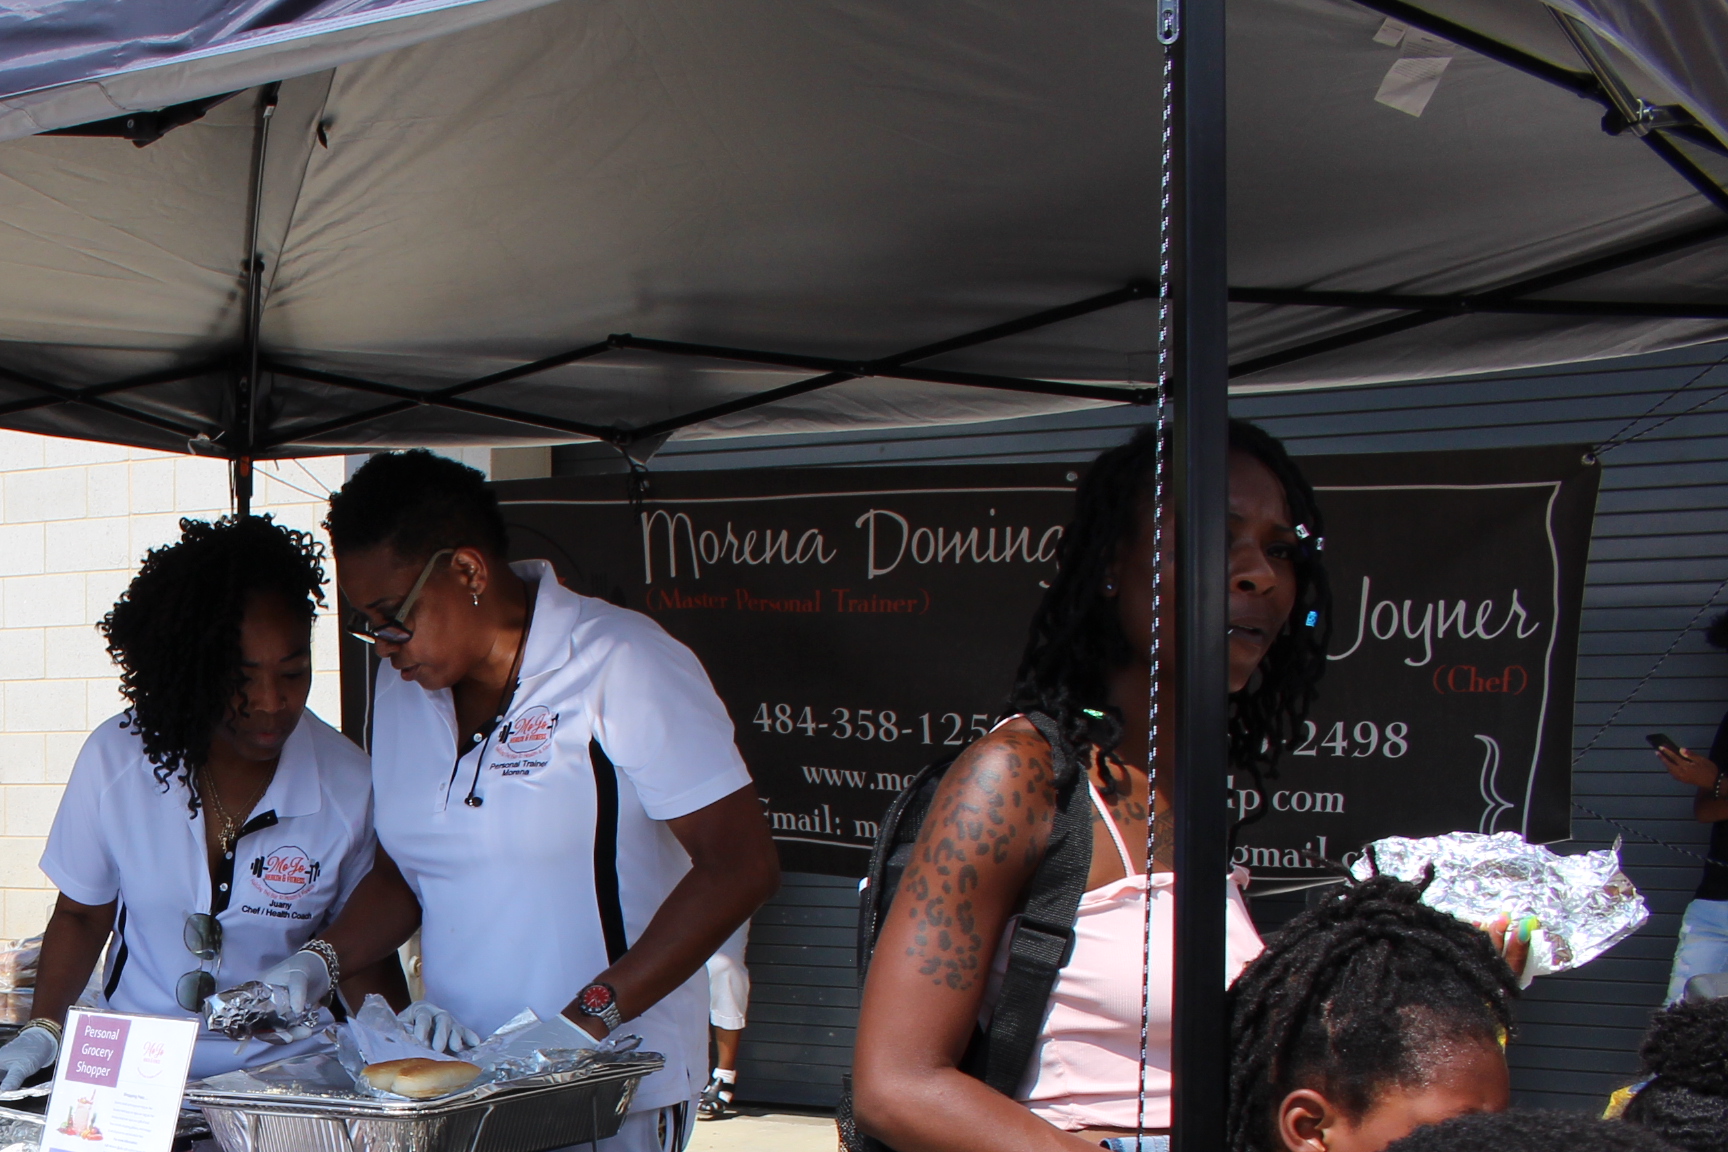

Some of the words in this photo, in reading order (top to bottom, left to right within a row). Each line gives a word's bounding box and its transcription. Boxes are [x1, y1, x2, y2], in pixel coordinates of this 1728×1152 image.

[641, 509, 837, 584] Morena
[736, 588, 821, 613] Personal
[1326, 576, 1540, 666] Joyner
[1432, 664, 1528, 695] (Chef)
[489, 760, 520, 770] Personal
[523, 760, 548, 768] Trainer
[267, 856, 306, 875] MoJo
[241, 905, 260, 915] Chef
[266, 909, 290, 918] Health
[84, 1025, 120, 1040] Personal
[81, 1043, 114, 1061] Grocery
[75, 1061, 111, 1078] Shopper
